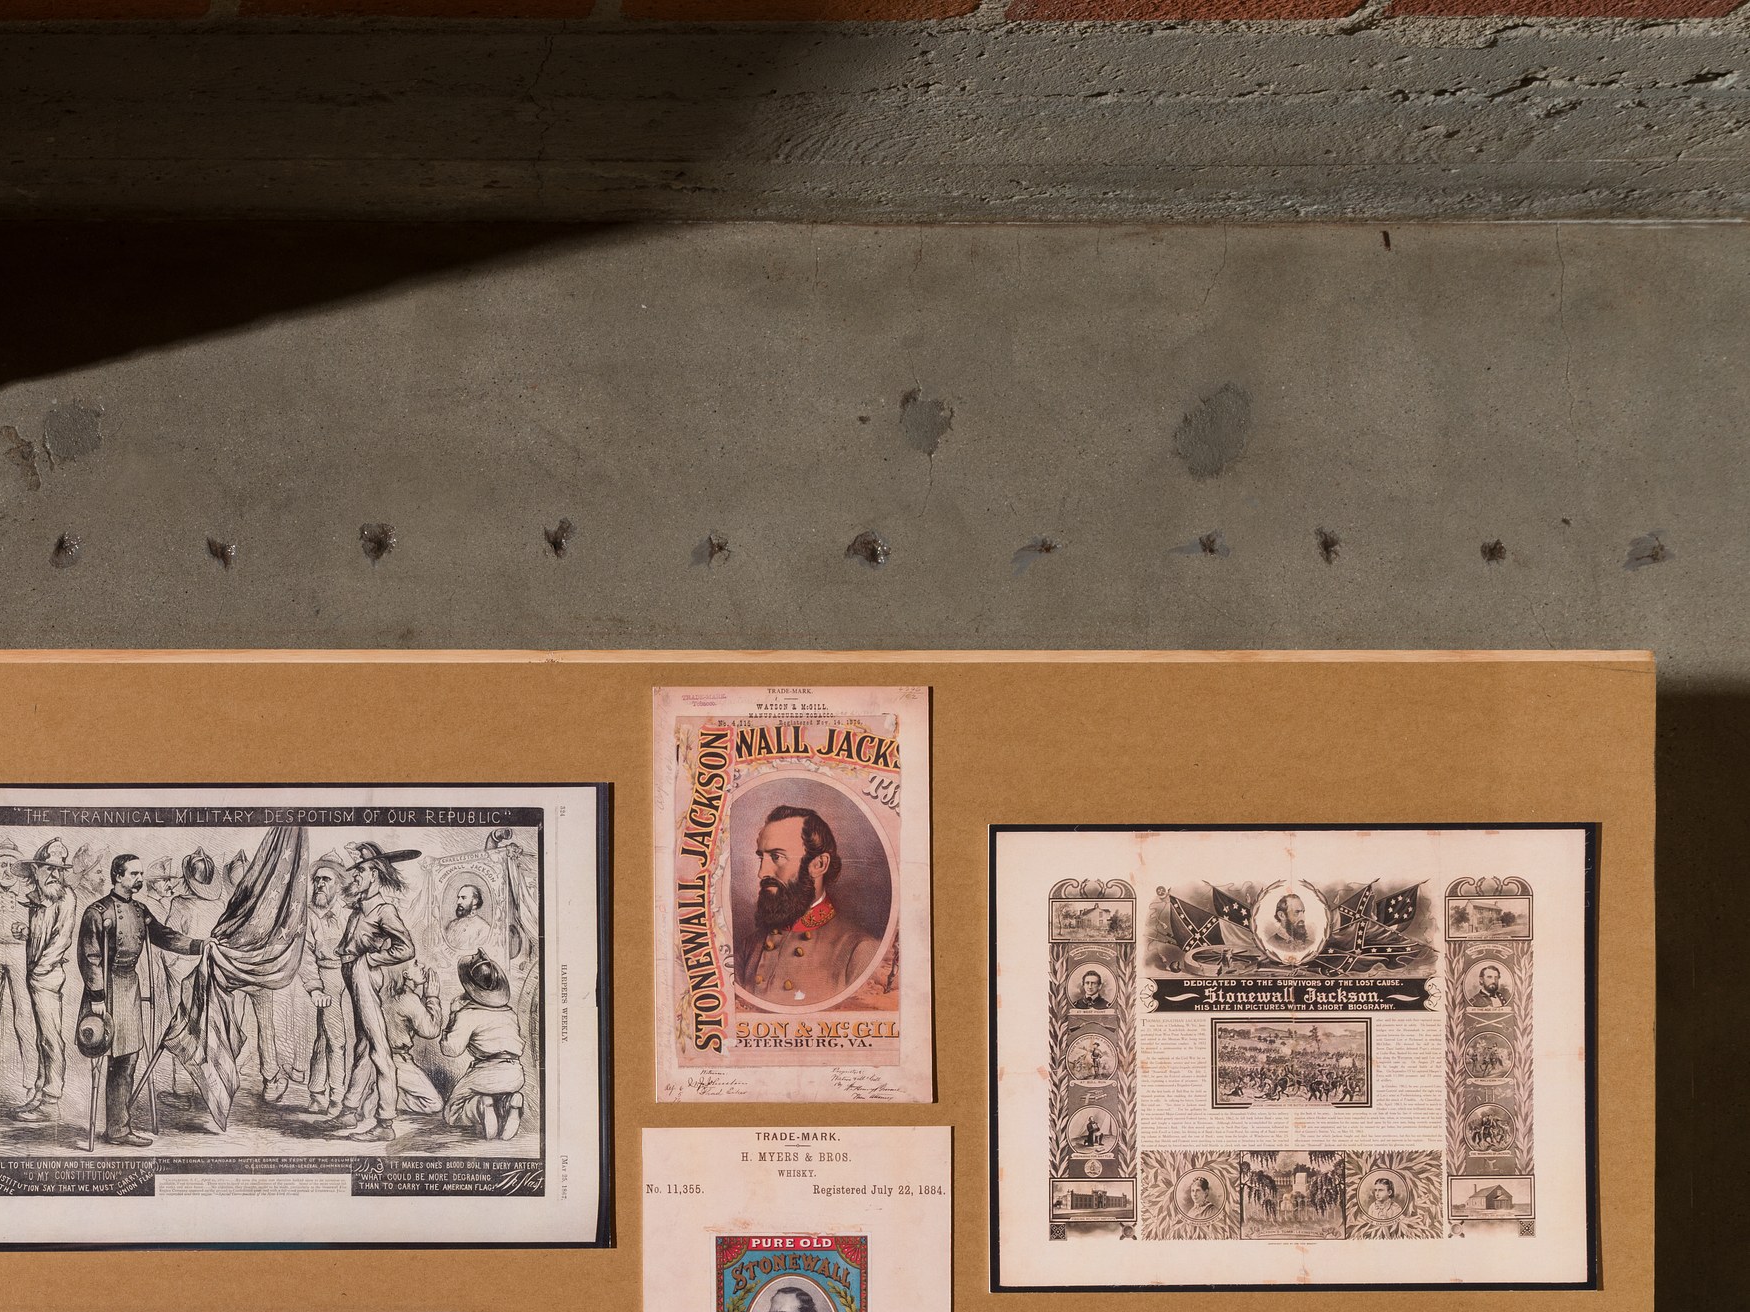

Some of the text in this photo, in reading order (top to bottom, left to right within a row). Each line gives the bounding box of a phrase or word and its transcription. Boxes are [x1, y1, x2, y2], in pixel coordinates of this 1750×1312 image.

[681, 730, 730, 868] JACKSON
[60, 810, 164, 824] TYRANNICAL
[176, 808, 254, 824] MILITARY
[264, 808, 354, 823] DESPOTISM
[363, 809, 381, 823] OF
[387, 809, 417, 824] OUR
[678, 870, 723, 1053] STONEWALL
[1203, 987, 1383, 1003] Stonewall Jackson.
[560, 964, 568, 1044] HARPER'S WEEKLY.
[736, 1021, 791, 1039] SON
[795, 1021, 813, 1039] &
[734, 1038, 872, 1049] PETERSBURG, VA.
[755, 1132, 841, 1142] TRADE-MARK.
[740, 1152, 852, 1162] H. MYERS & BROS.
[446, 1161, 465, 1169] BLOOD
[492, 1162, 511, 1170] EVERY
[388, 1173, 411, 1181] COULD
[415, 1173, 425, 1181] BE
[453, 1174, 491, 1182] DEGRADING
[778, 1170, 817, 1178] WHISKY.
[398, 1183, 420, 1191] CARRY
[646, 1184, 704, 1195] No. 11,355.
[812, 1184, 946, 1197] Registered July 22, 1884.
[751, 1238, 832, 1248] PURE OLD
[731, 1253, 851, 1295] STONEWALL
